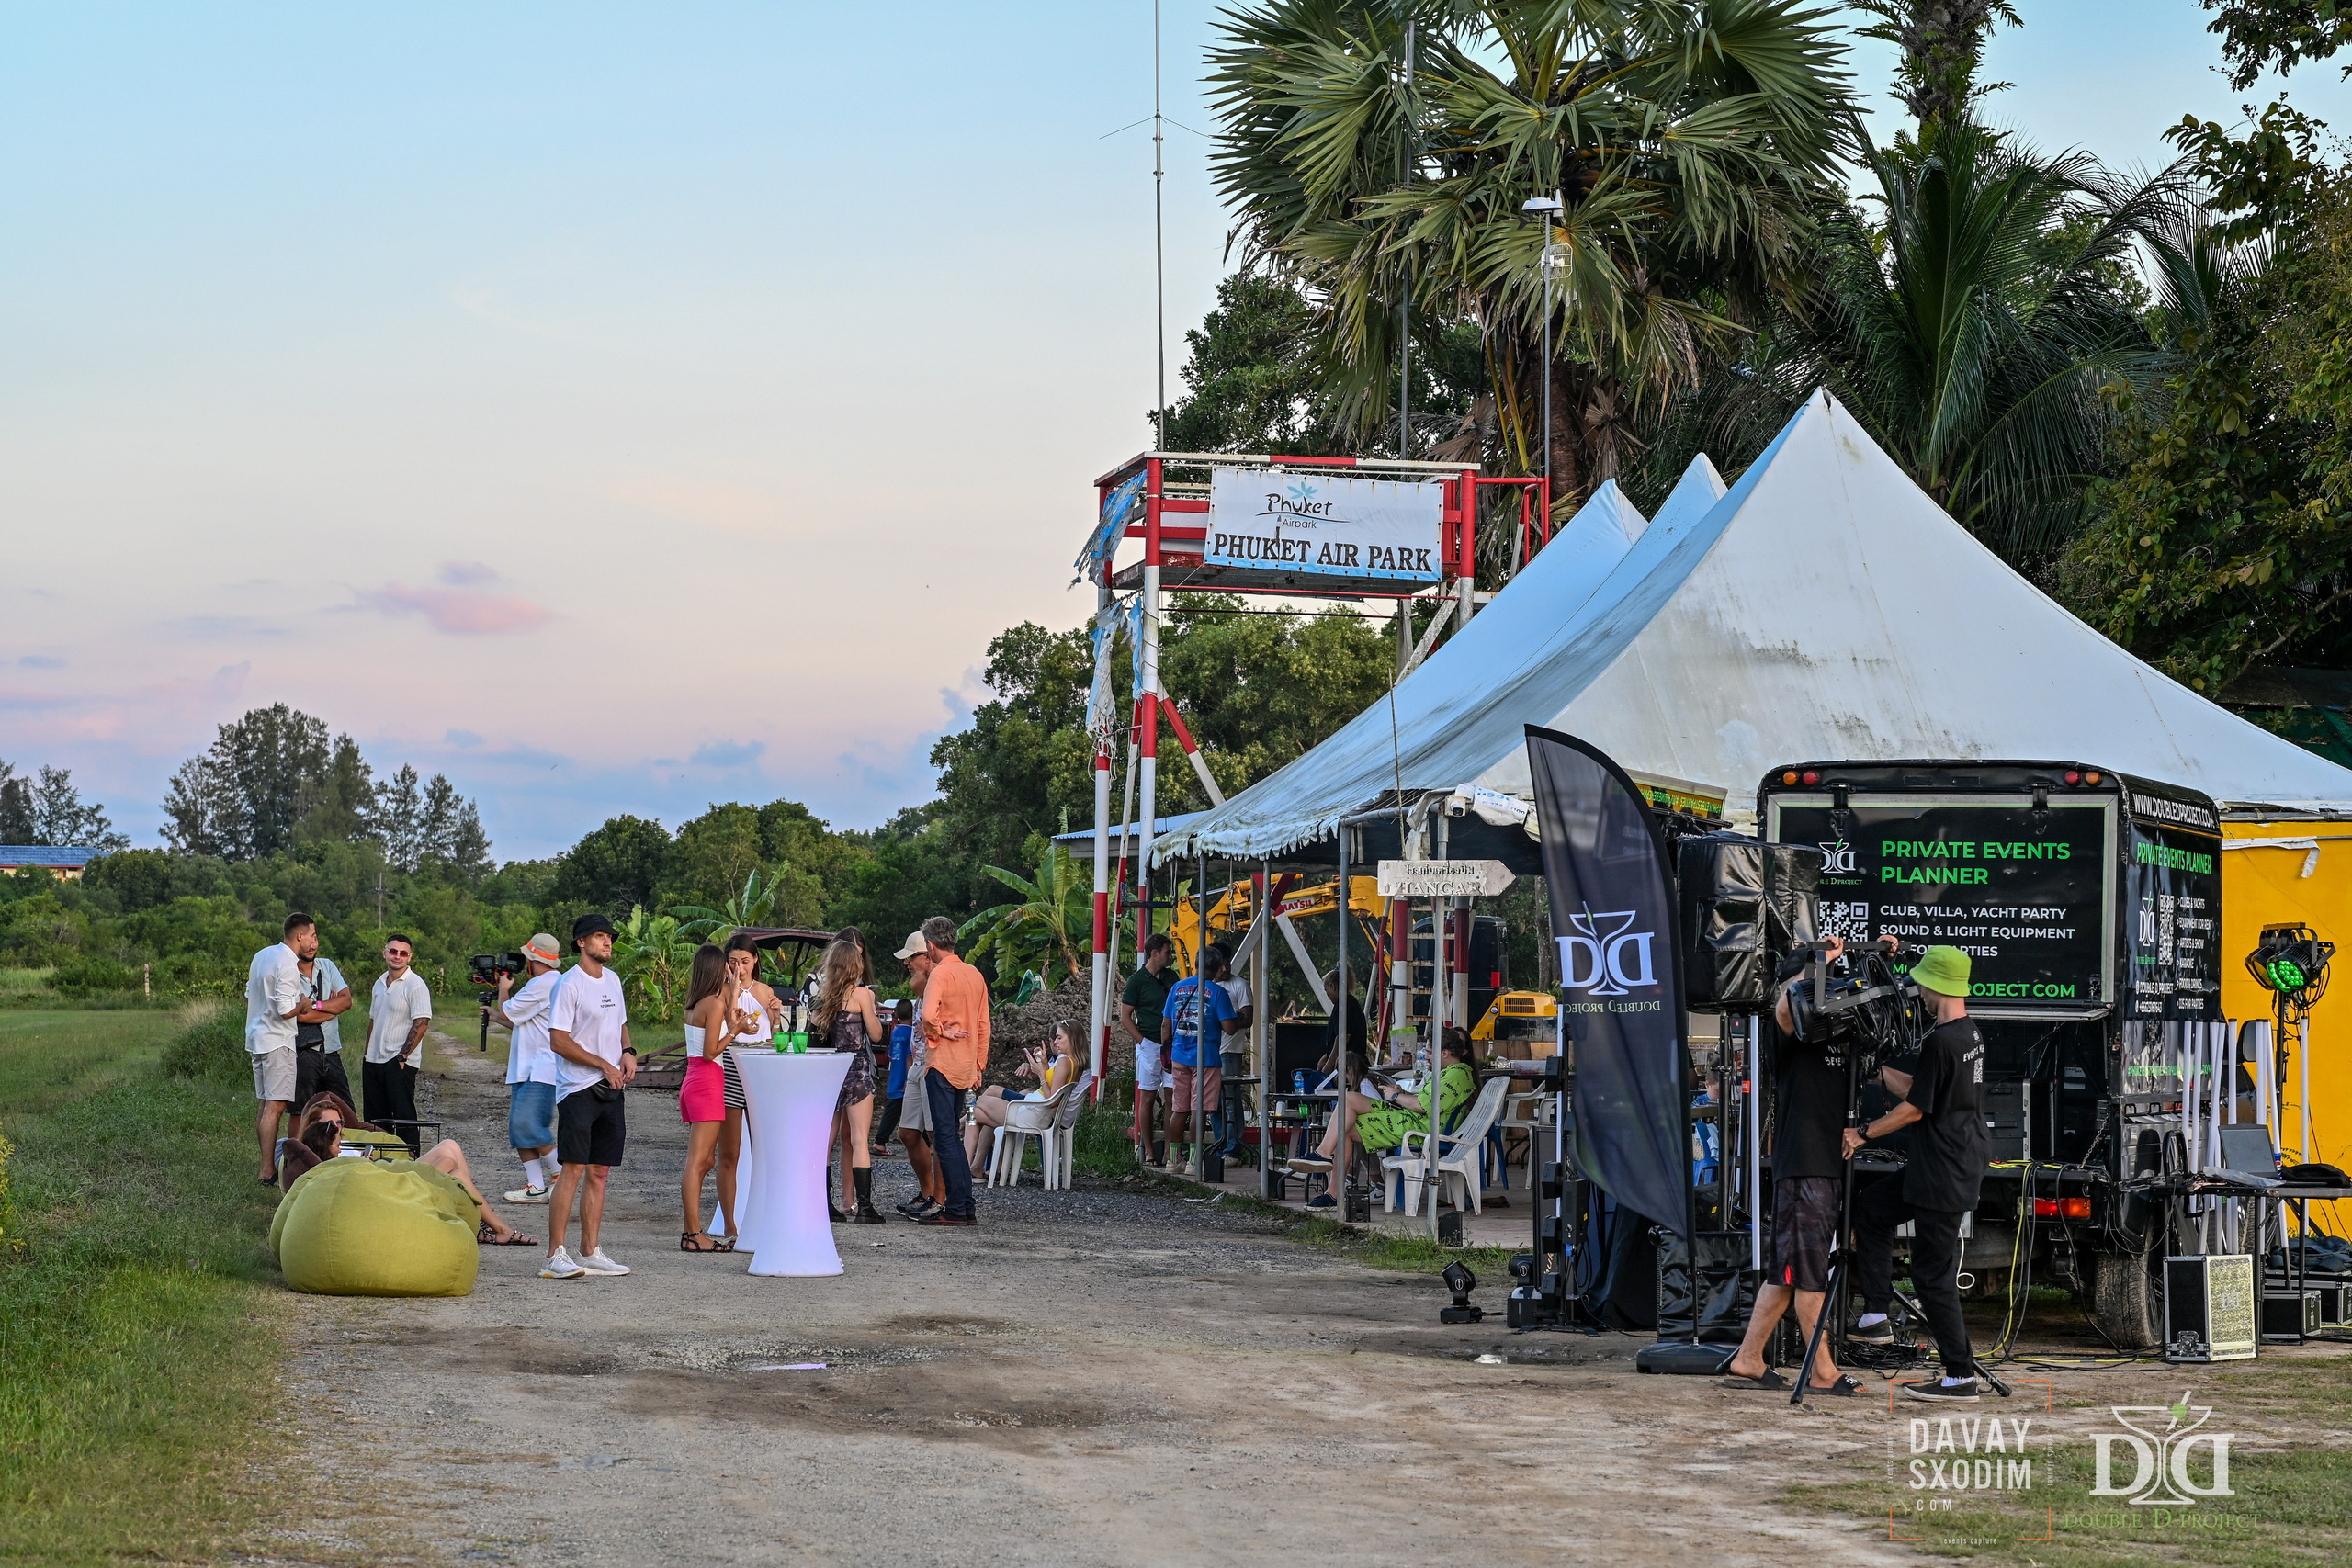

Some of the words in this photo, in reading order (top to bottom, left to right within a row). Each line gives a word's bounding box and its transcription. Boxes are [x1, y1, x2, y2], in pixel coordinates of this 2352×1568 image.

[1265, 492, 1333, 516] Phuket
[1282, 518, 1317, 529] Airpark
[1212, 532, 1312, 563] PHUKET
[1317, 542, 1360, 568] AIR
[1367, 545, 1432, 572] PARK
[1882, 840, 1975, 859] PRIVATE
[1983, 842, 2071, 860] EVENTS
[2136, 842, 2163, 865] PRIVATE
[2164, 846, 2186, 870] EVENTS
[2186, 851, 2212, 874] PLANNER
[1881, 866, 1989, 885] PLANNER
[1282, 898, 1312, 912] MATSU
[1880, 905, 1921, 919] CLUB,
[1924, 906, 1968, 919] VILLA,
[1971, 907, 2018, 919] YACHT
[2021, 908, 2067, 919] PARTY
[1879, 924, 1929, 936] SOUND
[1933, 925, 1943, 936] &
[1947, 926, 1988, 938] LIGHT
[1991, 927, 2075, 940] EQUIPMENT
[1911, 944, 1933, 955] FO
[1954, 945, 1998, 957] RTIES
